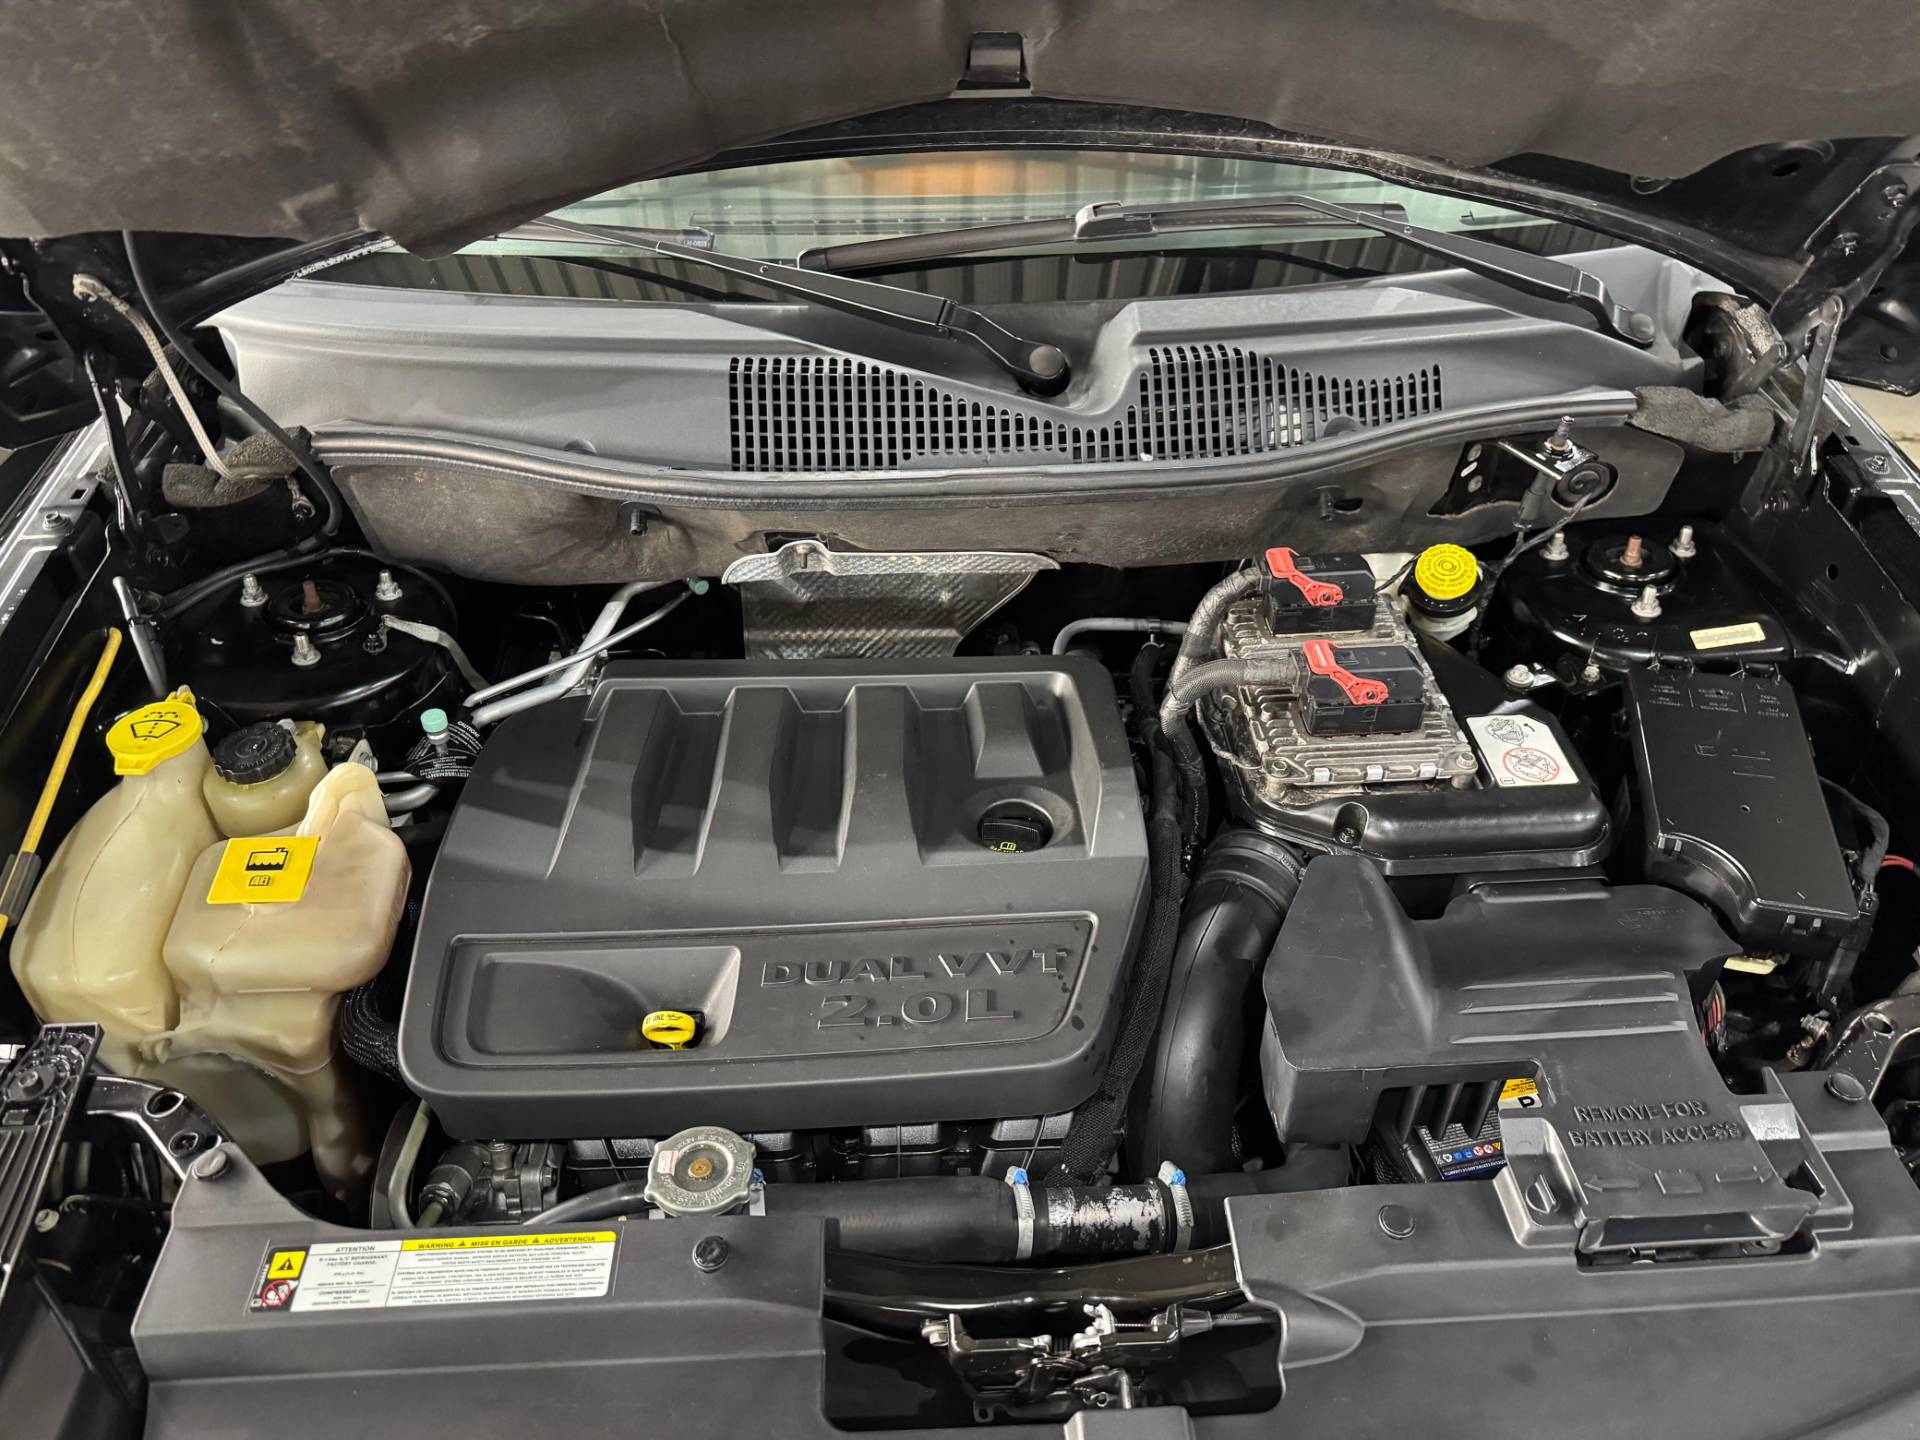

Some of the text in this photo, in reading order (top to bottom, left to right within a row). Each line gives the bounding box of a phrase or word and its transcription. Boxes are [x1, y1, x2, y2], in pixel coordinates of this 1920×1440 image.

[761, 948, 1068, 987] DUAL VVT
[816, 987, 1019, 1031] 2.0L
[1573, 1099, 1708, 1123] REMOVE FOR
[1568, 1129, 1654, 1147] BATTERY
